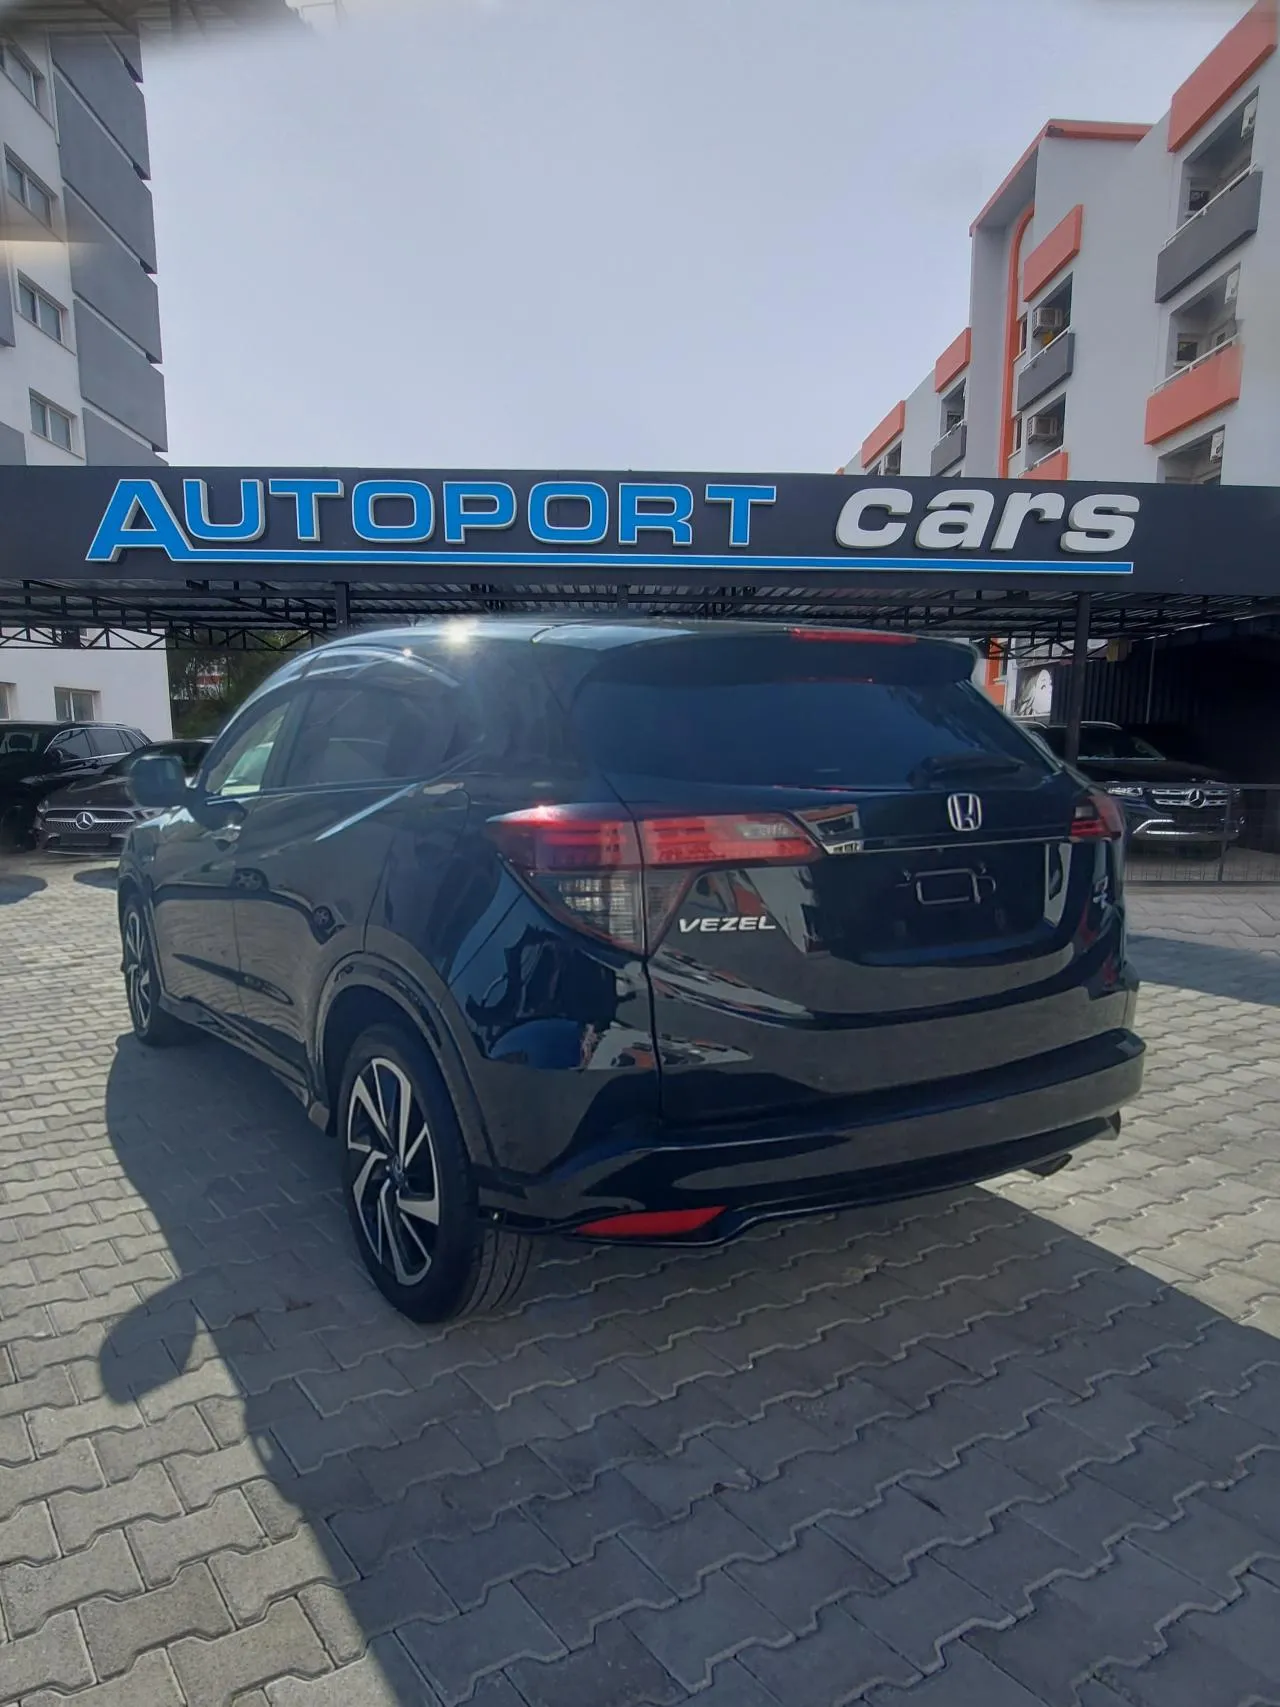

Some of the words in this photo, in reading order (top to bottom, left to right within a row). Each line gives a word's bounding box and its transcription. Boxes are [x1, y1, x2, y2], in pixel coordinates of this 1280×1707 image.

[85, 478, 777, 562] AUTOPORT
[835, 487, 1141, 554] cars
[679, 915, 777, 933] VEZEL
